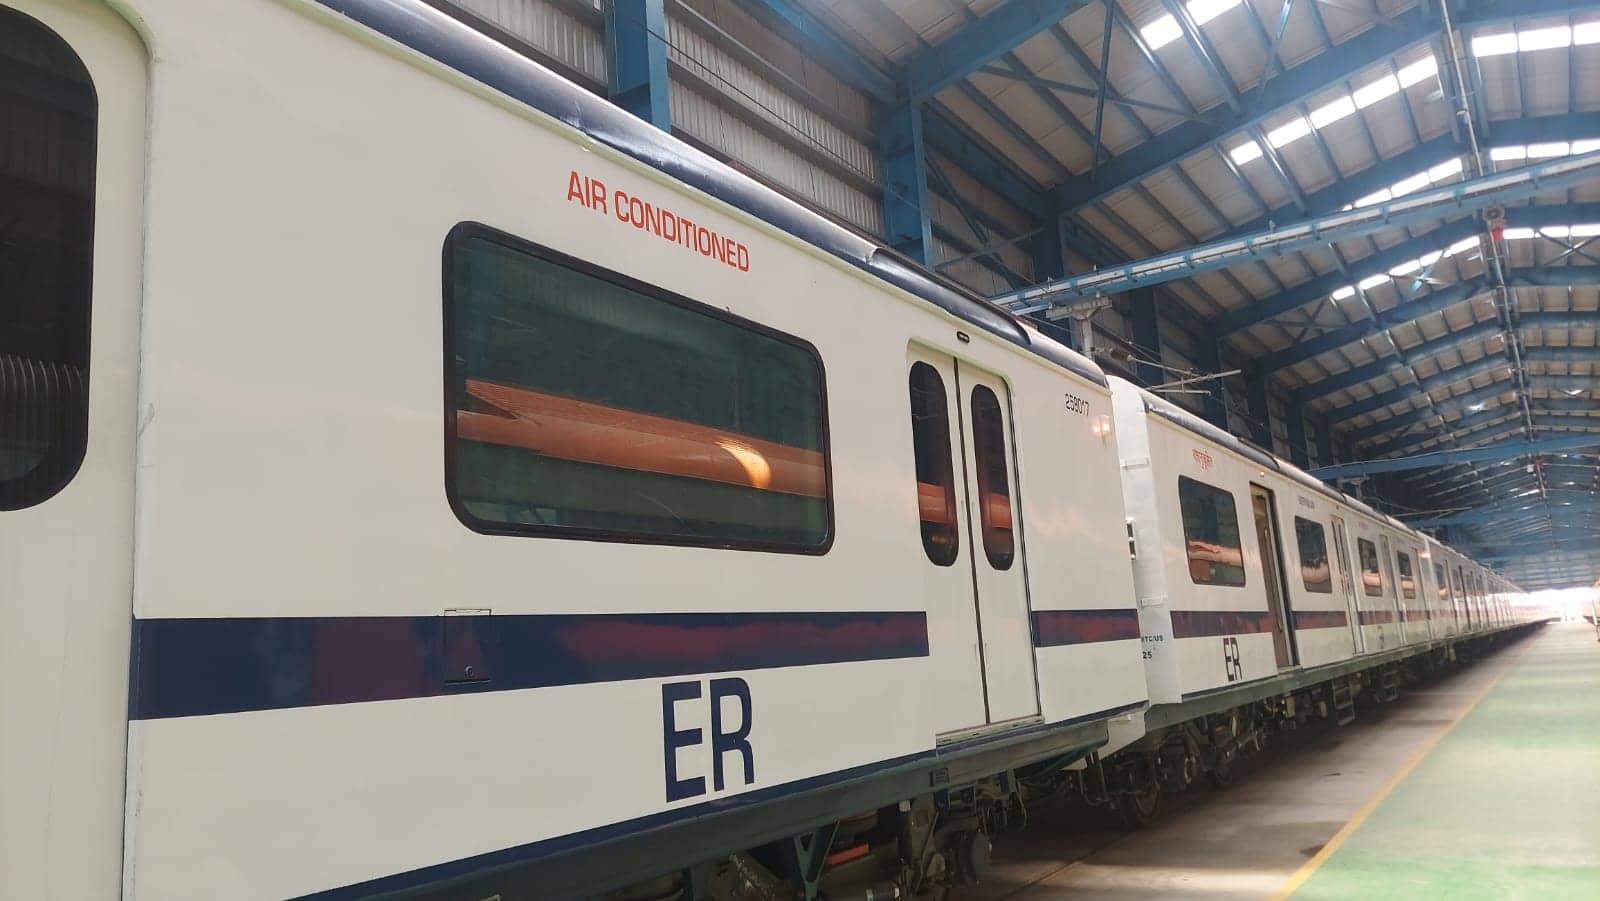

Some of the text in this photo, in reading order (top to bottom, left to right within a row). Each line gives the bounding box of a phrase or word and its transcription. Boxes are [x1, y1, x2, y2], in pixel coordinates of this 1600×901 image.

[567, 170, 750, 272] AIR CONDITIONED
[1223, 637, 1243, 681] ER
[662, 677, 754, 803] ER
